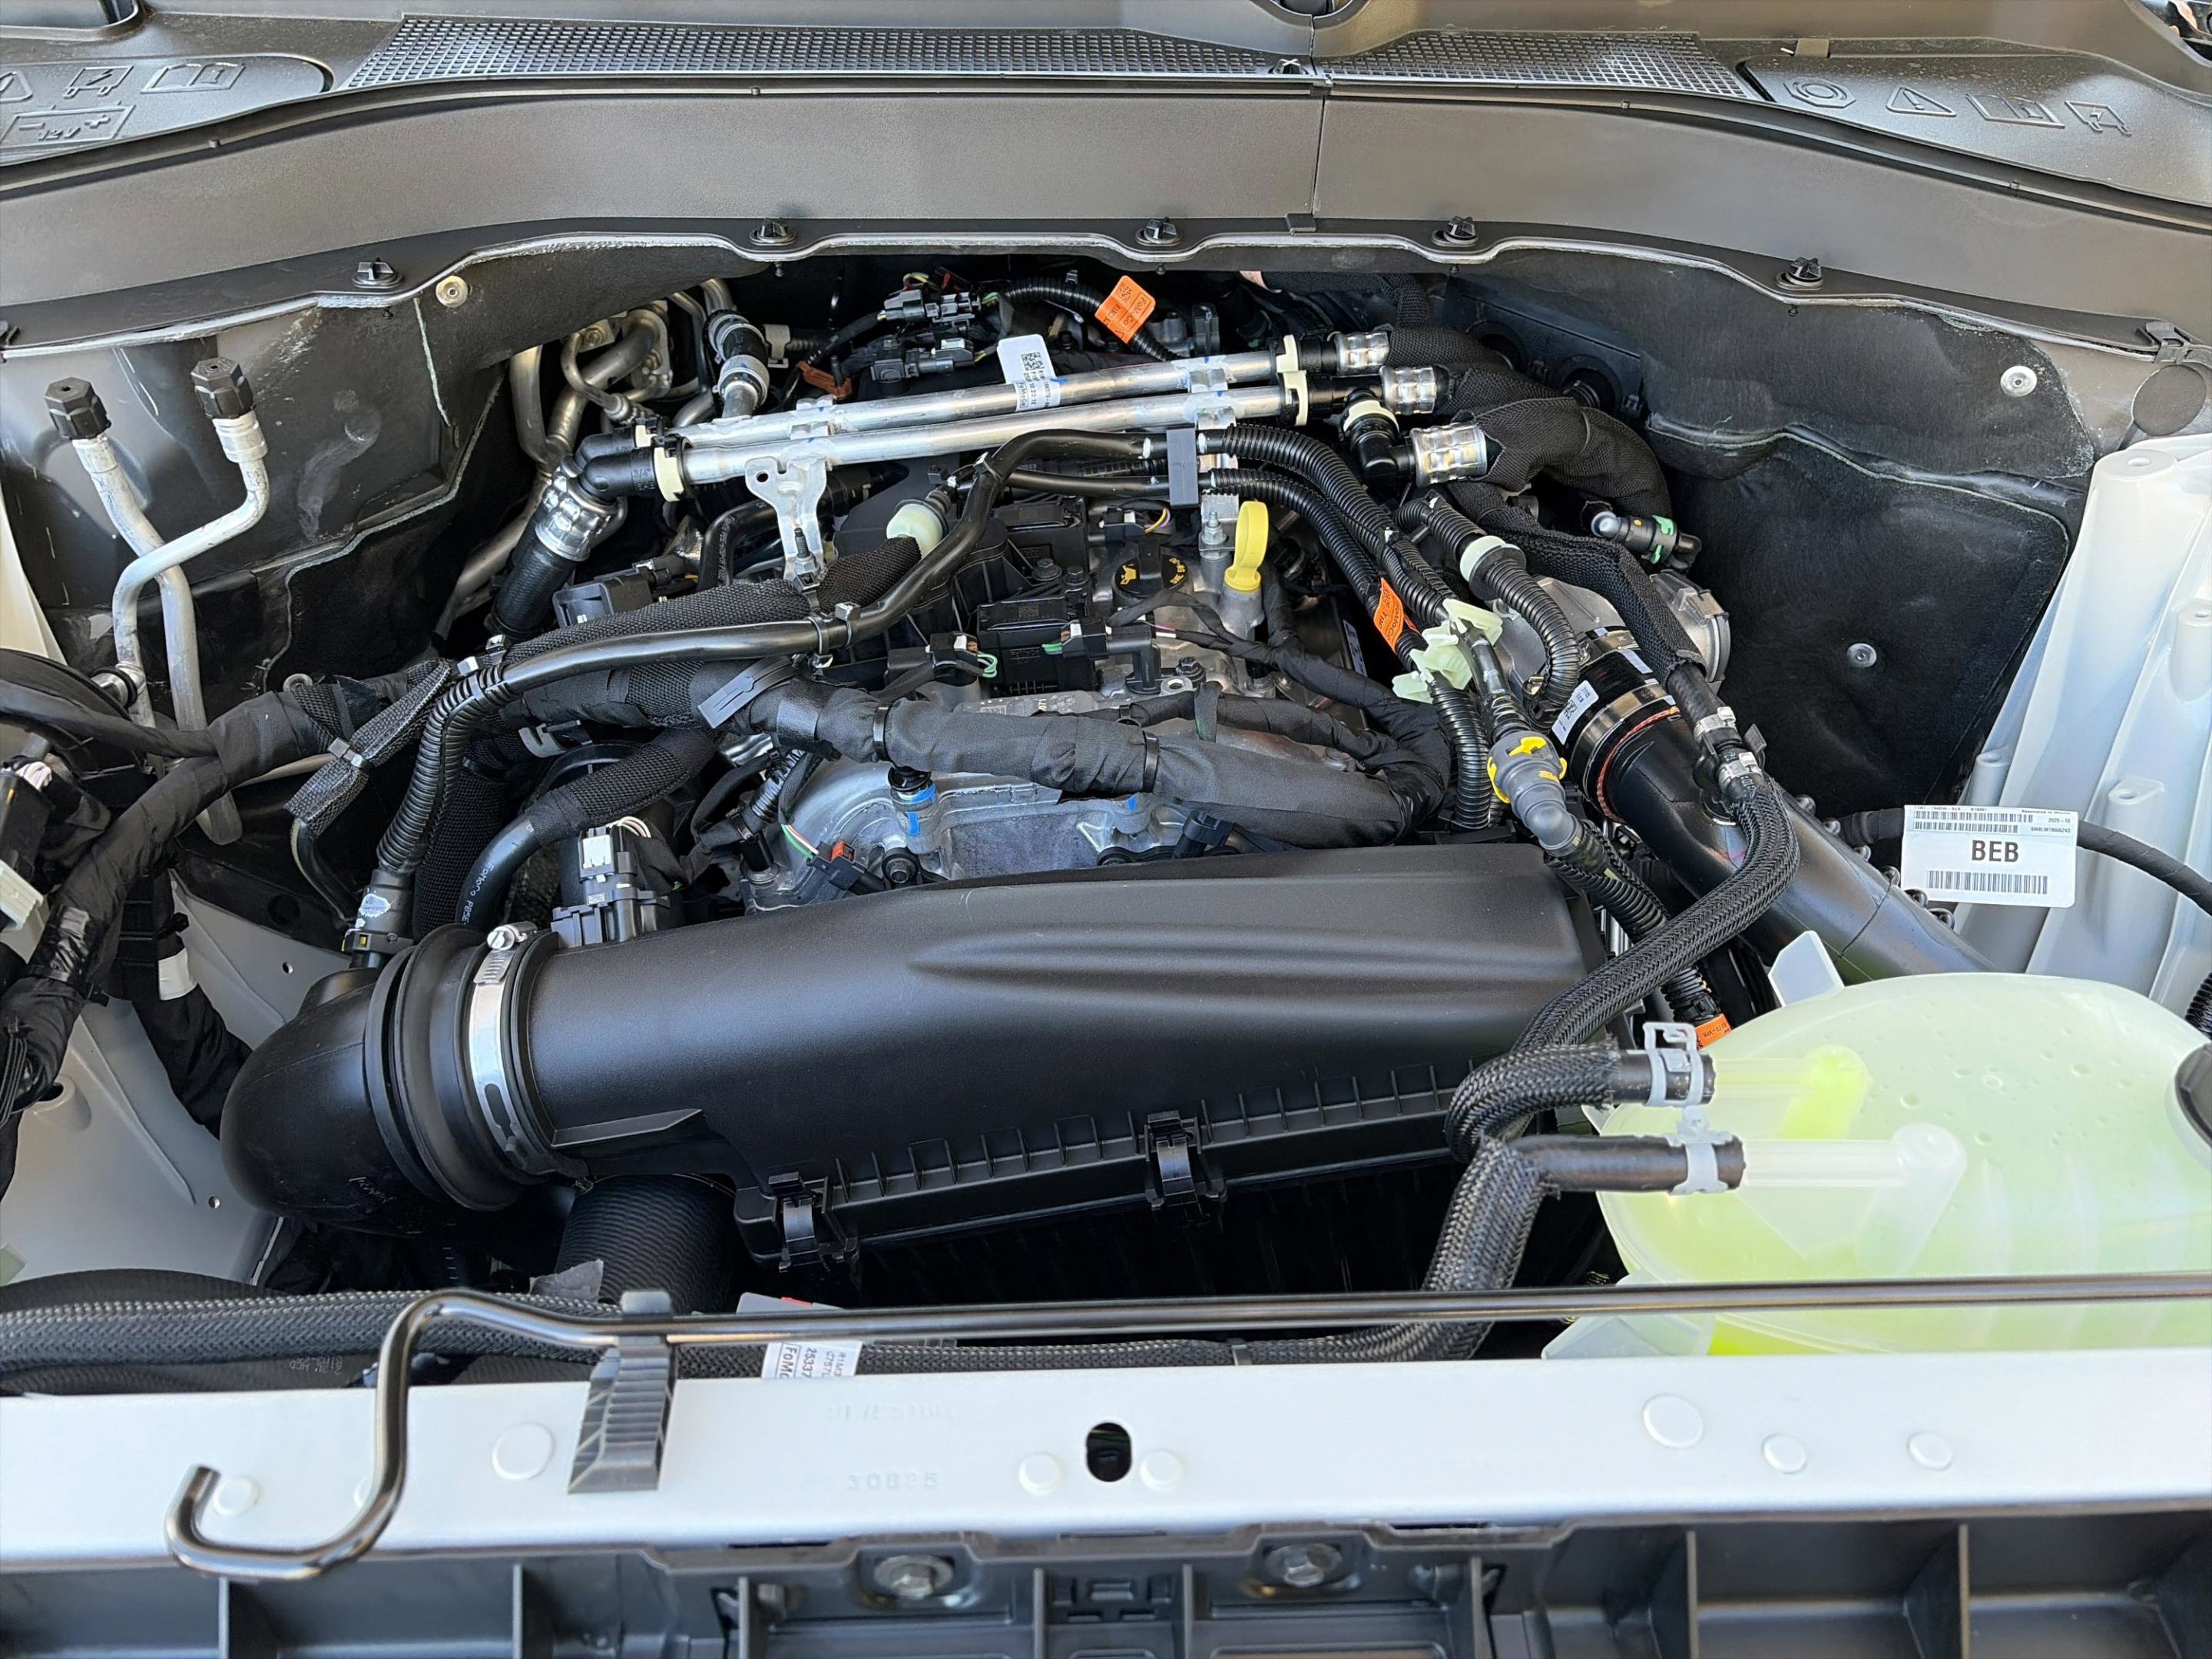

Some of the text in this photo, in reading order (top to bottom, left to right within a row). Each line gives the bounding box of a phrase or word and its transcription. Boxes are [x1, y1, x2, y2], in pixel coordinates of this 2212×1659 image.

[38, 127, 81, 141] 12V
[1123, 296, 1147, 326] FoMoCo
[1972, 839, 2019, 862] BEB
